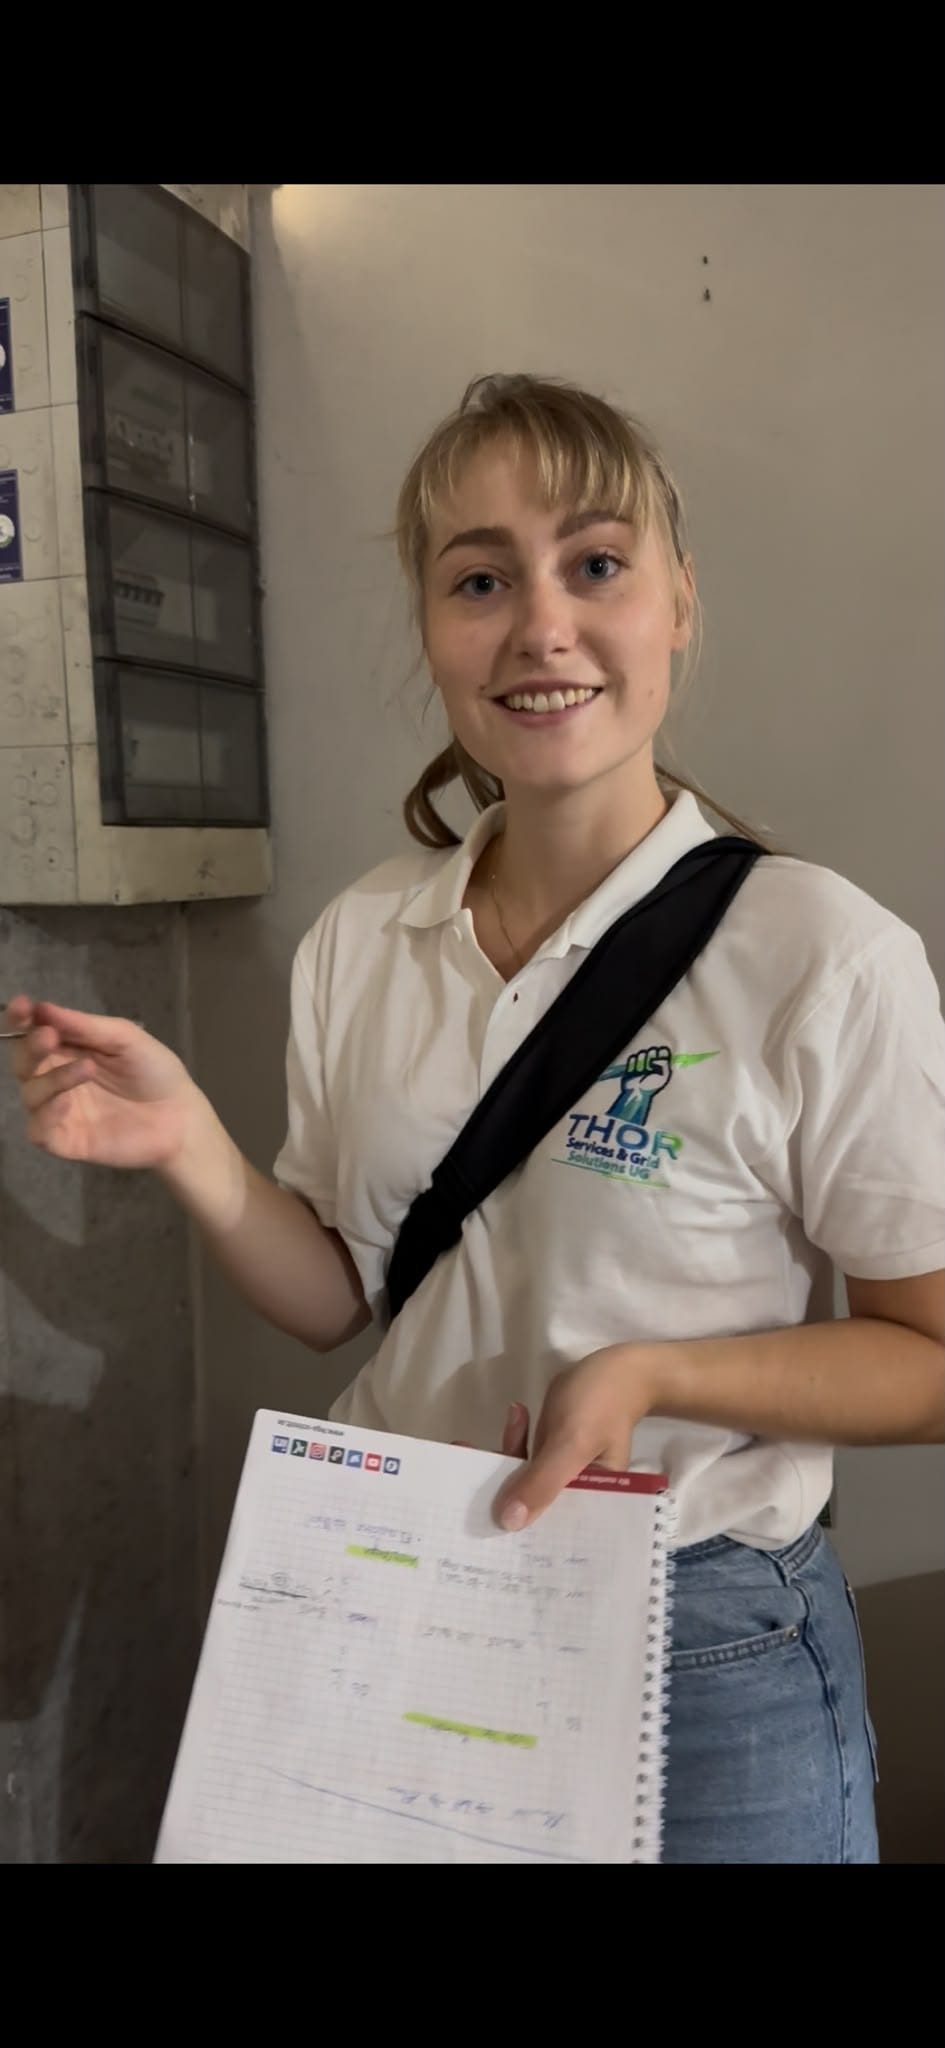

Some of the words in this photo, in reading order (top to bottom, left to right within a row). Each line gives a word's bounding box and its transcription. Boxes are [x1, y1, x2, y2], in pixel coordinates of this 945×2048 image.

[568, 1113, 683, 1160] THOR
[566, 1137, 614, 1158] Services
[616, 1148, 628, 1161] &
[630, 1151, 660, 1169] Grid
[568, 1150, 627, 1174] Solutions
[629, 1165, 650, 1179] UG
